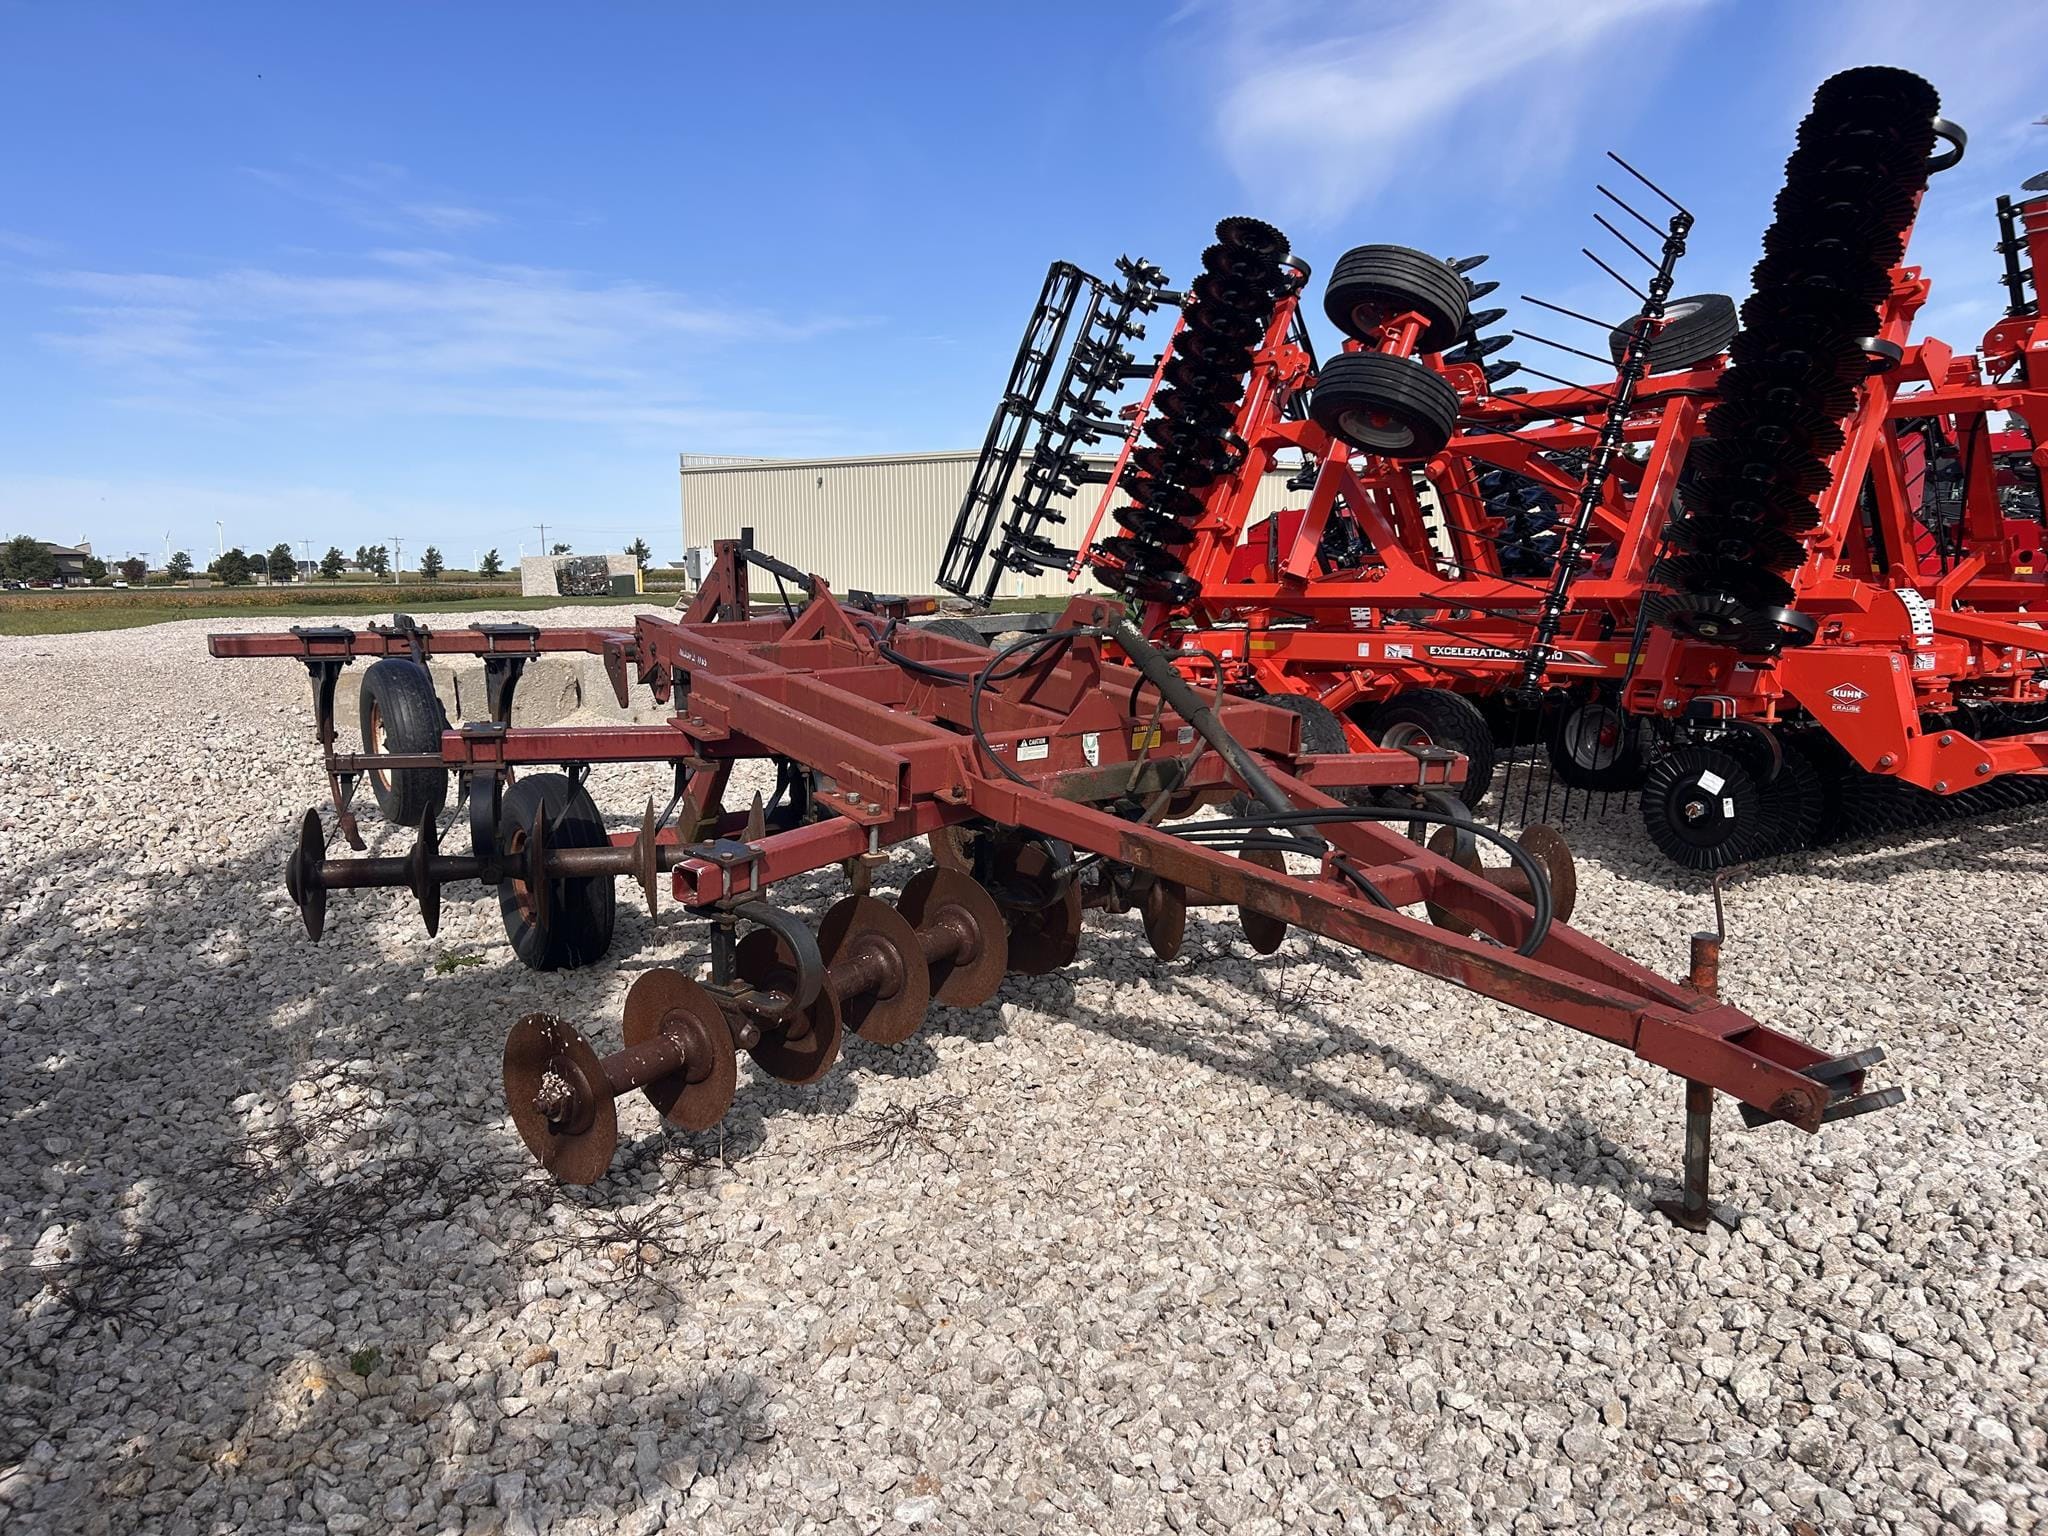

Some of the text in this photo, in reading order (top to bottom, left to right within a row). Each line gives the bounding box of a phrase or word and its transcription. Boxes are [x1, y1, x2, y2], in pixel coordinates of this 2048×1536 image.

[1430, 646, 1510, 658] EXCELERATOR
[1833, 690, 1862, 698] KUHN
[1832, 704, 1861, 712] KRAUSE
[1028, 738, 1046, 746] CAUTION
